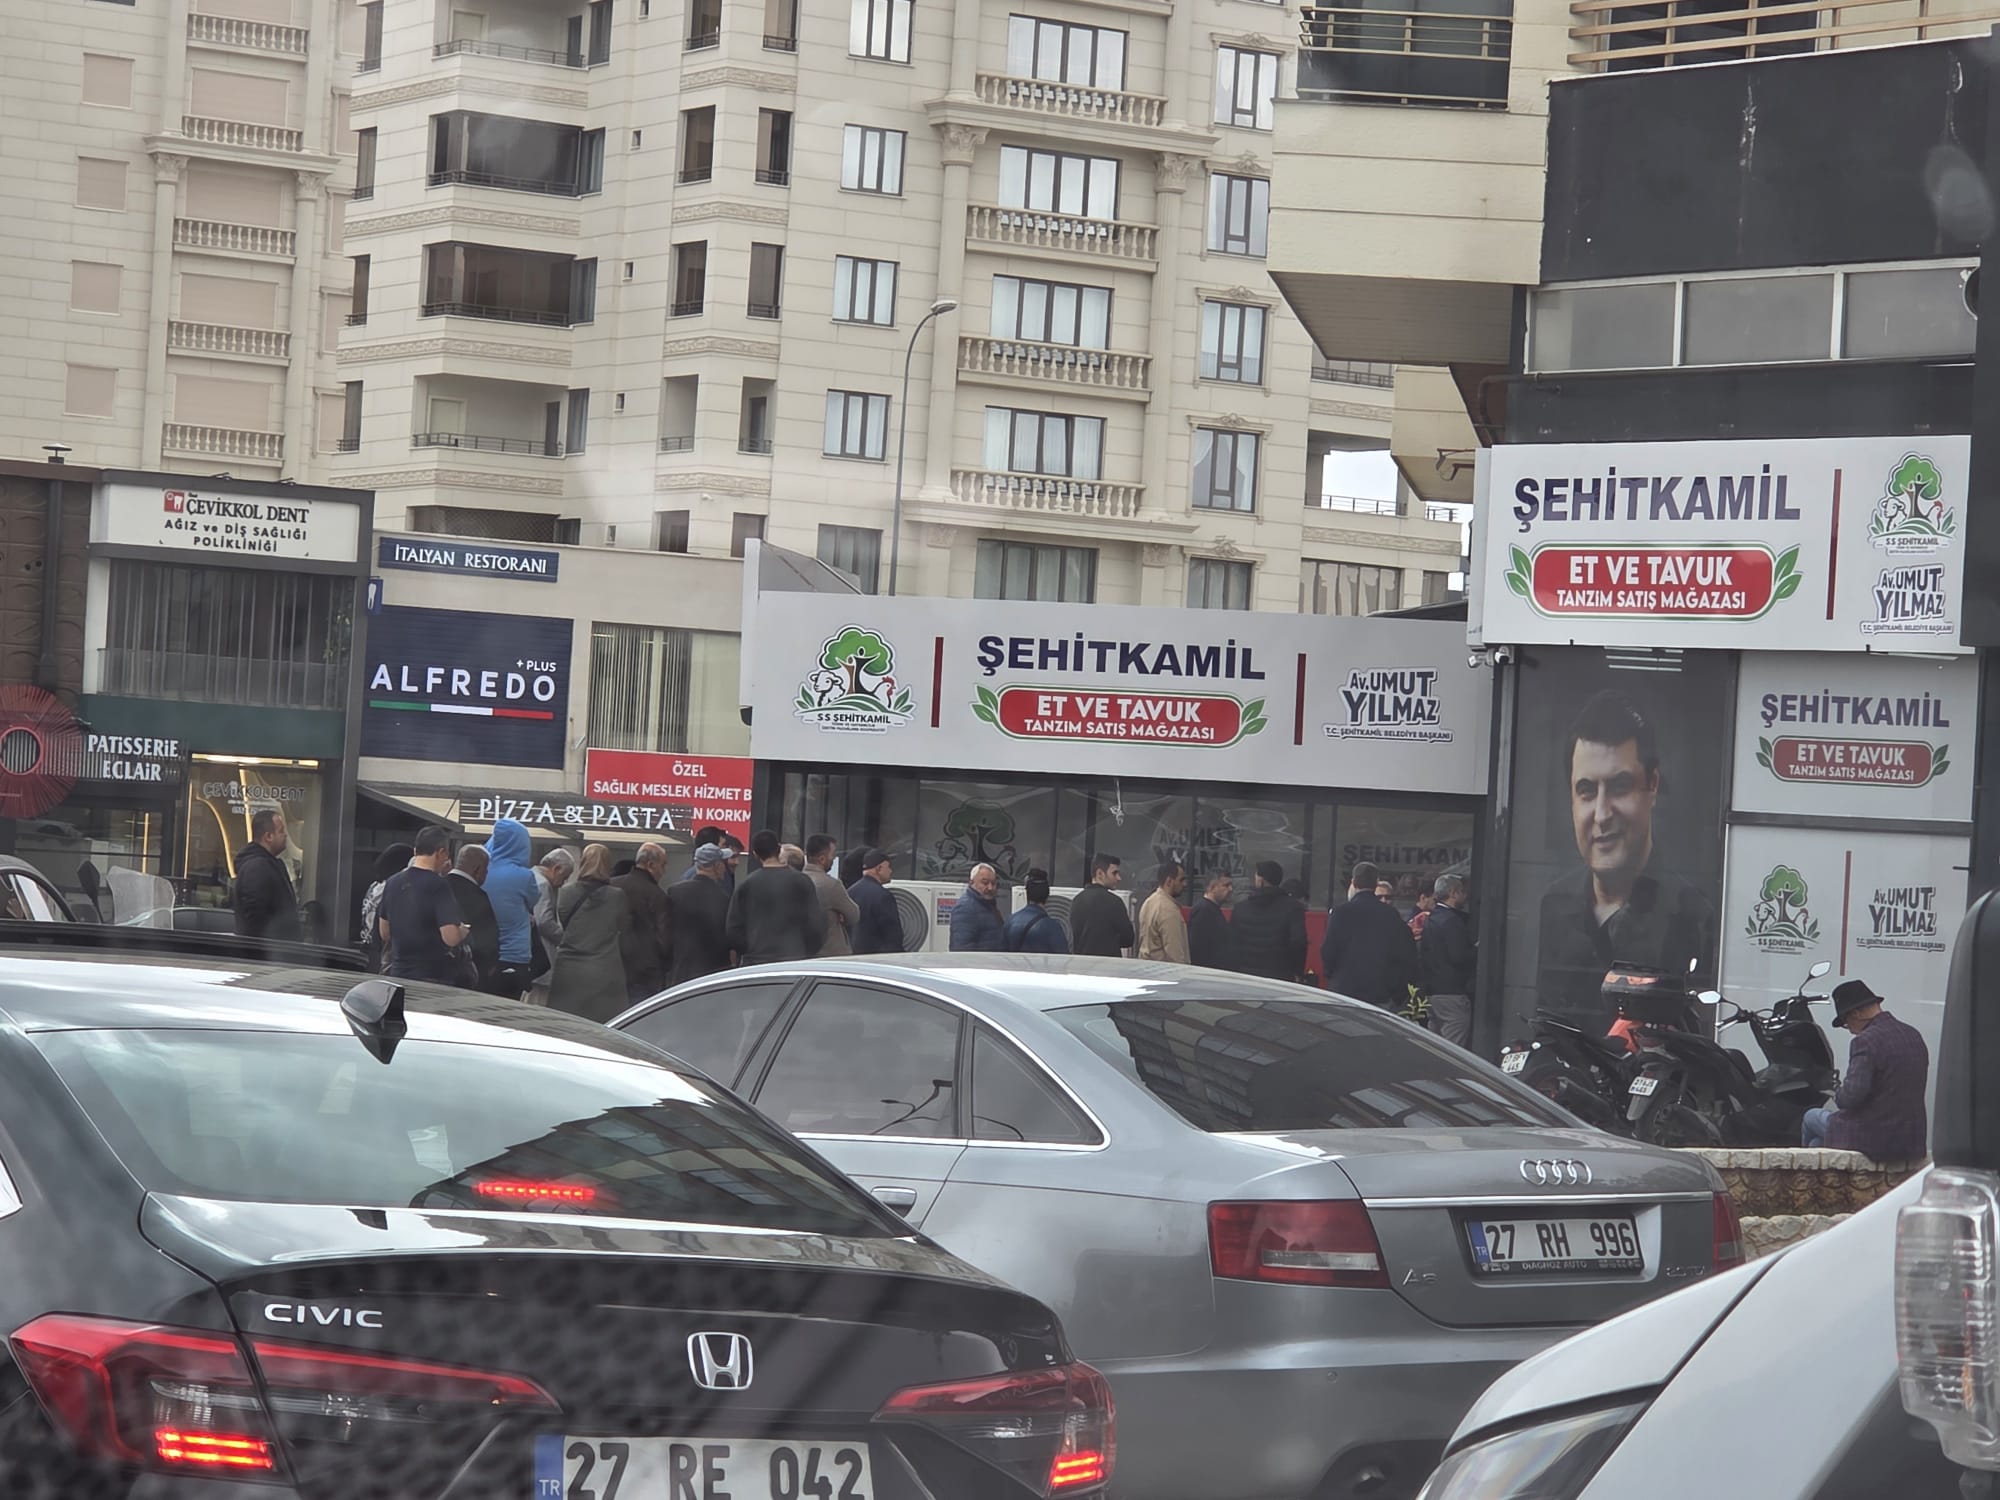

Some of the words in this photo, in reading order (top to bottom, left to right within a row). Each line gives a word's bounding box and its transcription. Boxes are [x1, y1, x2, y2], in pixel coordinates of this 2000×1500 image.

[186, 497, 263, 520] ÇEVİKKOL
[267, 506, 309, 523] DENT
[1513, 464, 1801, 533] ŞEHİTKAMİL
[164, 518, 198, 531] AĞIZ
[225, 523, 247, 537] DİŞ
[253, 527, 307, 540] SAĞLIĞI
[193, 535, 277, 552] POLİKLİNİĞİ
[1569, 556, 1599, 584] ET
[1606, 556, 1640, 585] VE
[1647, 556, 1733, 586] TAVUK
[1616, 591, 1657, 610] SATIŞ
[1661, 587, 1746, 609] MAĞAZASI
[1876, 590, 1943, 619] YILMAZ
[977, 632, 1265, 680] ŞEHİTKAMİL
[370, 663, 556, 702] ALFREDO
[1037, 695, 1068, 717] ET
[1075, 696, 1109, 719] VE
[1117, 699, 1201, 723] TAVUK
[1342, 690, 1437, 722] YILMAZ
[1760, 689, 1950, 729] ŞEHİTKAMİL
[1086, 722, 1127, 737] SATIŞ
[1131, 722, 1215, 740] MAĞAZASI
[673, 760, 707, 777] ÖZEL
[1797, 743, 1818, 763] ET
[1822, 745, 1845, 764] VE
[1849, 746, 1905, 767] TAVUK
[1828, 766, 1856, 779] SATIŞ
[1858, 765, 1914, 781] MAĞAZASI
[593, 778, 639, 796] SAĞLIK
[642, 783, 692, 799] MESLEK
[694, 783, 741, 800] HİZMET
[479, 795, 556, 824] PİZZA
[564, 805, 585, 824] &
[592, 805, 676, 831] PASTA
[1868, 904, 1934, 933] YILMAZ
[1476, 1246, 1488, 1256] TR
[1485, 1224, 1516, 1261] 27
[1536, 1223, 1571, 1258] RH
[1590, 1222, 1636, 1258] 996
[264, 1302, 383, 1328] CIVIC
[539, 1479, 560, 1497] TR
[566, 1442, 629, 1500] 27
[669, 1443, 732, 1500] RE
[769, 1446, 866, 1500] 042
